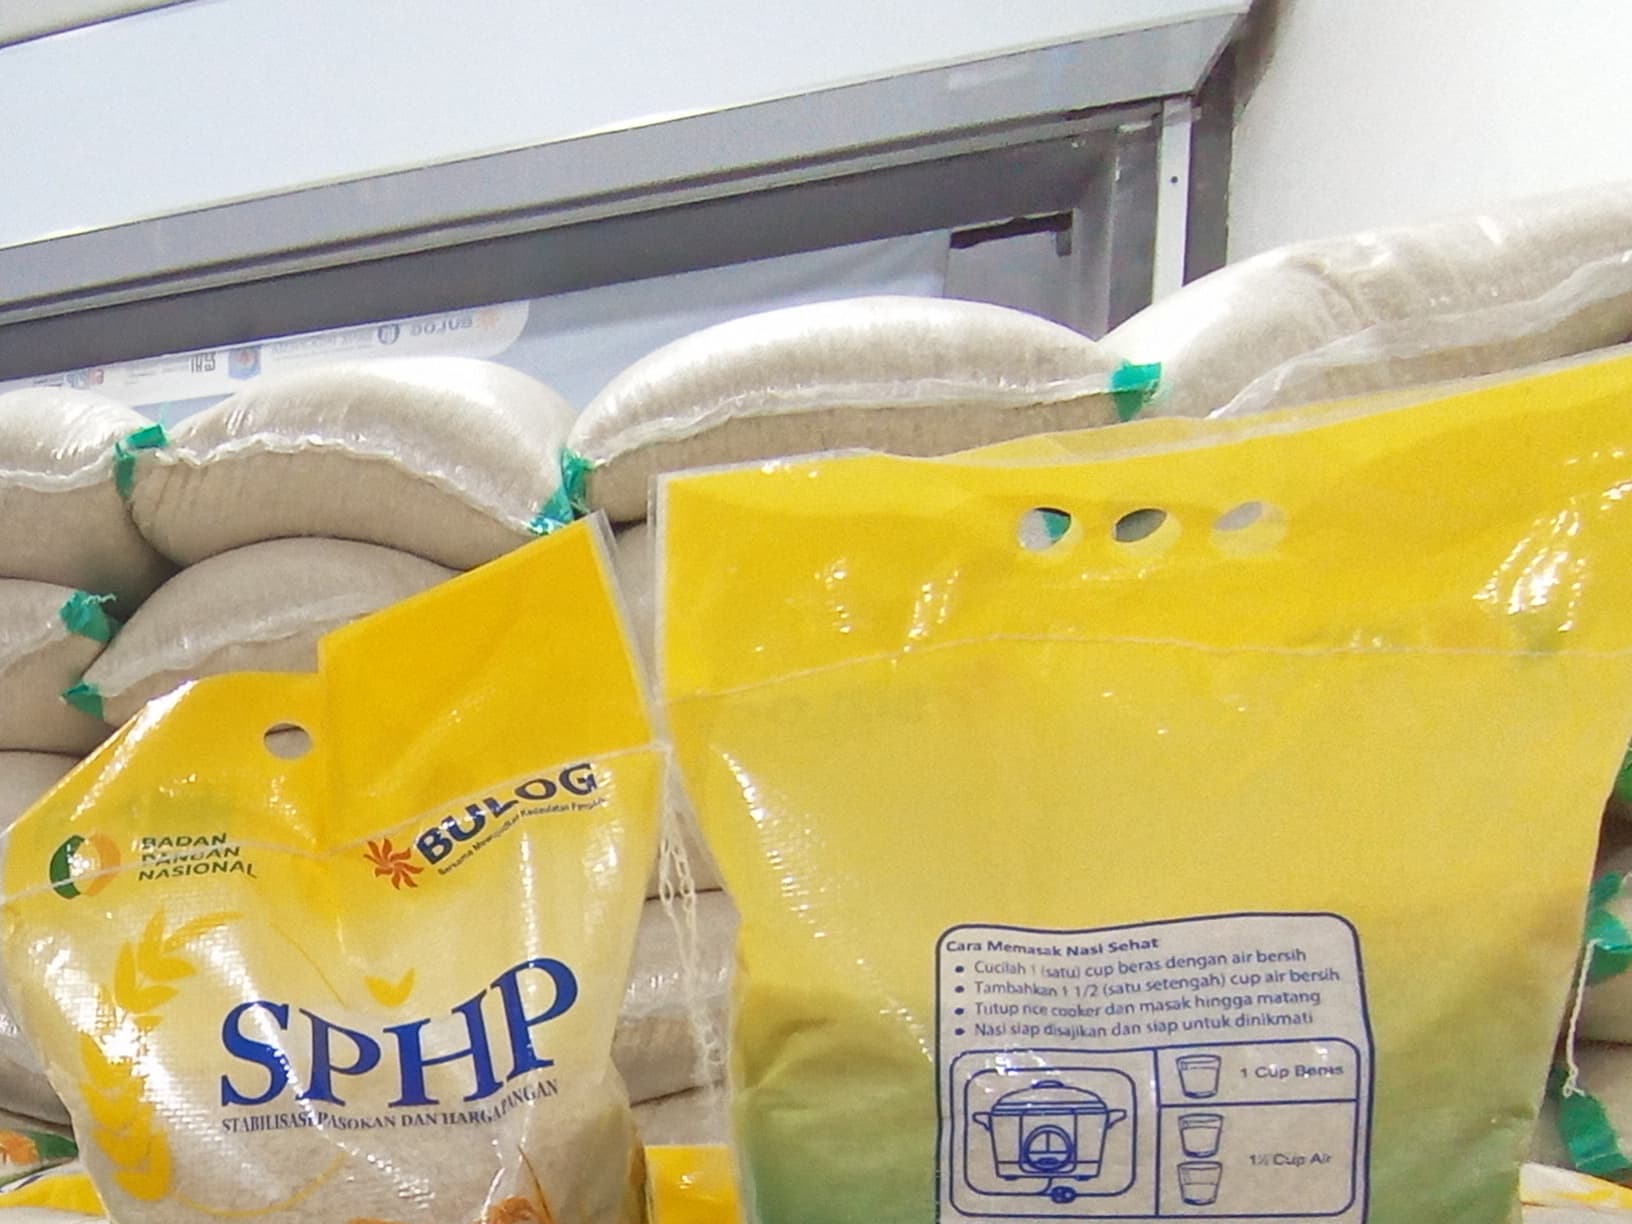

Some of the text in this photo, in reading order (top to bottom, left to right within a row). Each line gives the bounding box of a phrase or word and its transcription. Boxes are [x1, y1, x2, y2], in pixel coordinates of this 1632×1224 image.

[416, 762, 598, 866] BULOG
[142, 832, 227, 850] BADAN
[138, 860, 257, 881] NASIONAL
[946, 937, 1159, 957] Cara Memasak Nasi Sehat
[974, 960, 1026, 975] Cucilah
[1041, 965, 1081, 979] (satu)
[1085, 965, 1114, 978] cup
[1118, 960, 1161, 973] beras
[1165, 954, 1228, 970] dengan
[1232, 951, 1253, 964] air
[1256, 948, 1307, 963] bersih
[975, 981, 1058, 997] Tambahkan
[1076, 984, 1098, 998] 1/2
[1103, 981, 1141, 996] (satu
[1146, 973, 1226, 992] setengah)
[1230, 974, 1261, 987] cup
[1265, 970, 1286, 983] air
[1289, 968, 1340, 982] bersih
[975, 991, 1321, 1017] Tutup rice cooker dan masak hingga matang
[220, 957, 579, 1107] SPHP
[975, 1012, 1313, 1040] Nasi siap disajikan dan siap untuk dinikmati
[1240, 1068, 1248, 1078] 1
[1254, 1065, 1290, 1079] Cup
[221, 1079, 559, 1133] STABILISASI PASOKAN DAN HARGA PANGAN
[1272, 1153, 1306, 1168] Cup
[1310, 1152, 1333, 1164] Air
